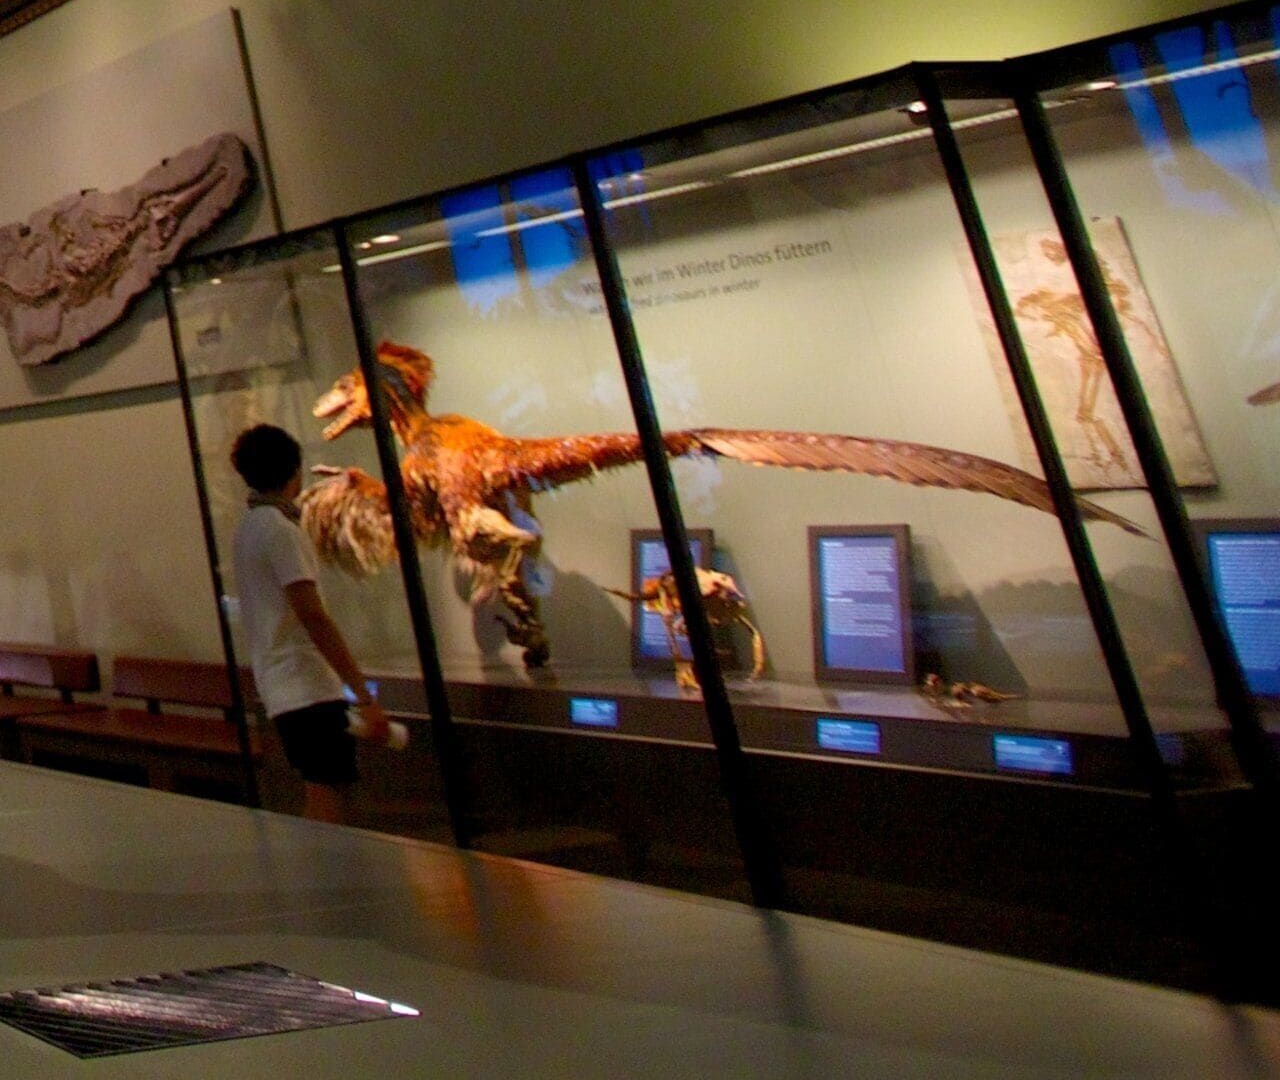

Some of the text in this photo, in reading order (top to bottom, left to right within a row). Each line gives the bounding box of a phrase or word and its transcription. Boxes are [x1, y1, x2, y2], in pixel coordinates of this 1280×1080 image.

[632, 271, 654, 287] wir
[656, 268, 675, 283] im
[676, 258, 727, 279] Winter
[728, 249, 772, 271] Dinos
[774, 238, 832, 261] füttern
[721, 278, 760, 295] winter
